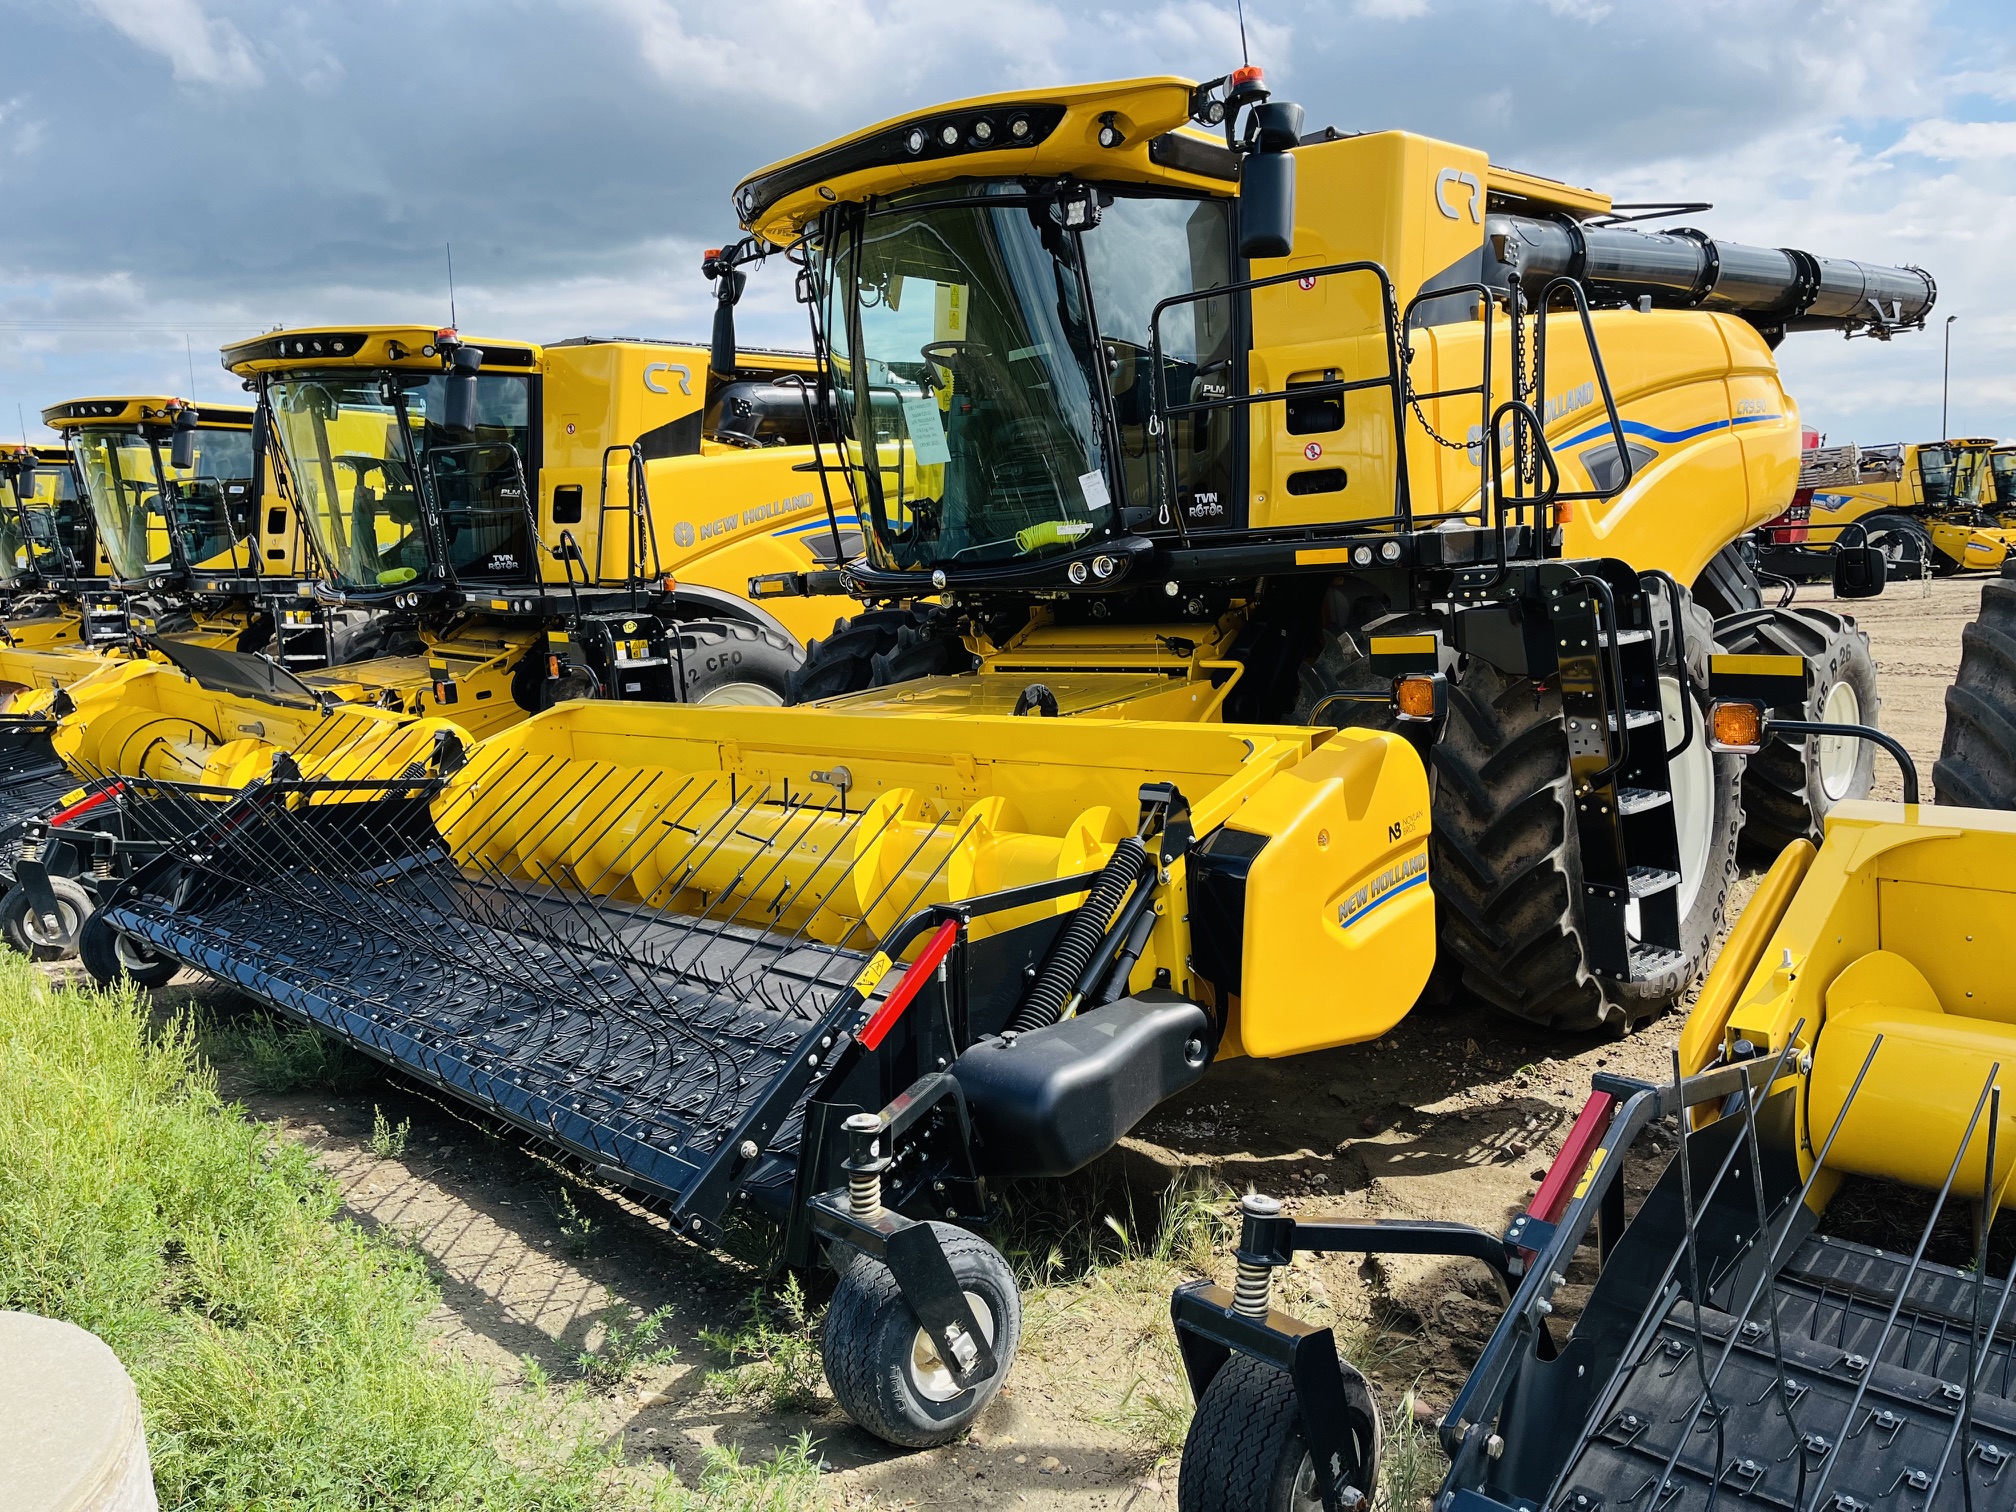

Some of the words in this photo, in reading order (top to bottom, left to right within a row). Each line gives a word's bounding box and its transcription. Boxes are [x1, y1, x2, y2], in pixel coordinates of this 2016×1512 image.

[1434, 167, 1480, 225] CR
[643, 361, 692, 396] CR
[1203, 384, 1226, 394] PLM
[1543, 381, 1595, 425] OLLAND
[1737, 399, 1767, 415] CR9.90
[1194, 492, 1218, 503] TWIN
[700, 513, 739, 541] NEW
[743, 492, 814, 526] HOLLAND
[1189, 502, 1224, 517] ROTOR
[488, 561, 519, 569] ROTOR
[624, 622, 638, 631] TCA
[706, 650, 743, 672] CFO
[1829, 657, 1838, 680] R
[1839, 643, 1852, 667] 26
[1402, 810, 1423, 826] NOVLAN
[1403, 823, 1416, 836] BROS
[1338, 884, 1368, 923] NEW
[1371, 852, 1427, 899] HOLLAND
[1684, 955, 1700, 984] 42
